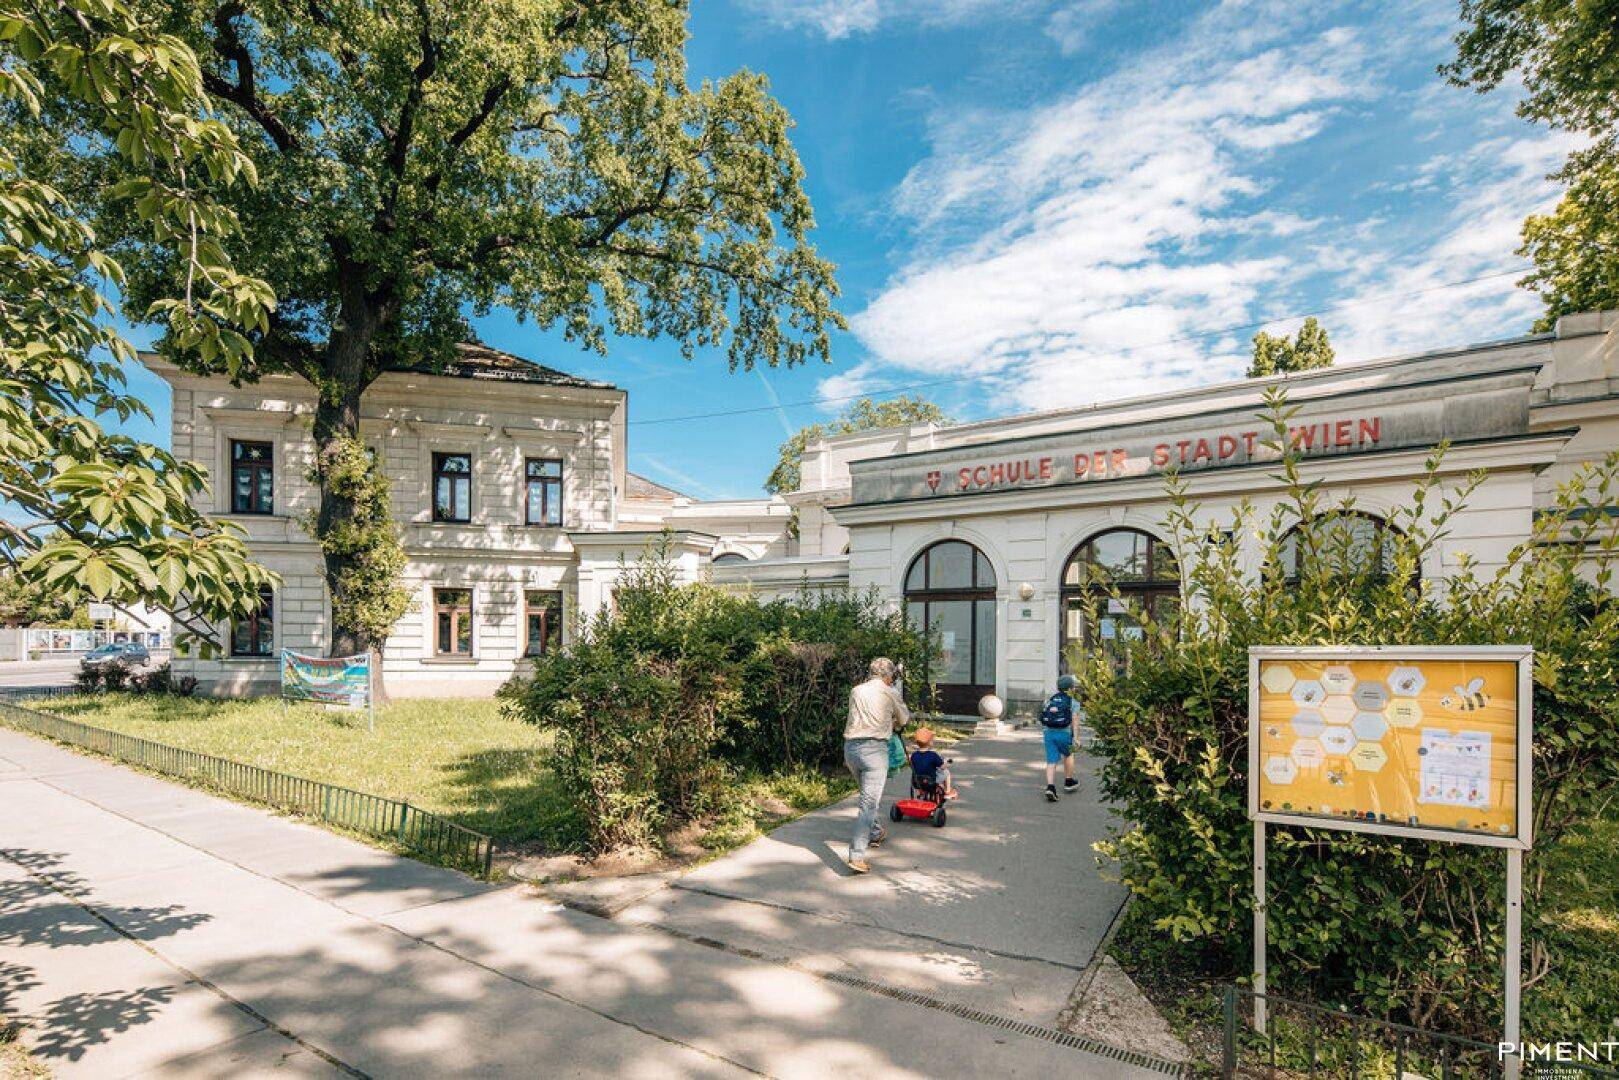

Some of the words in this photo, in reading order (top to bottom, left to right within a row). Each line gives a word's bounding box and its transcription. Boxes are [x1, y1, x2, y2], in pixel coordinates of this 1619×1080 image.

[957, 458, 1053, 490] SCHULE
[1074, 447, 1129, 478] DER
[1152, 431, 1259, 466] STADT
[1289, 416, 1380, 451] WIEN
